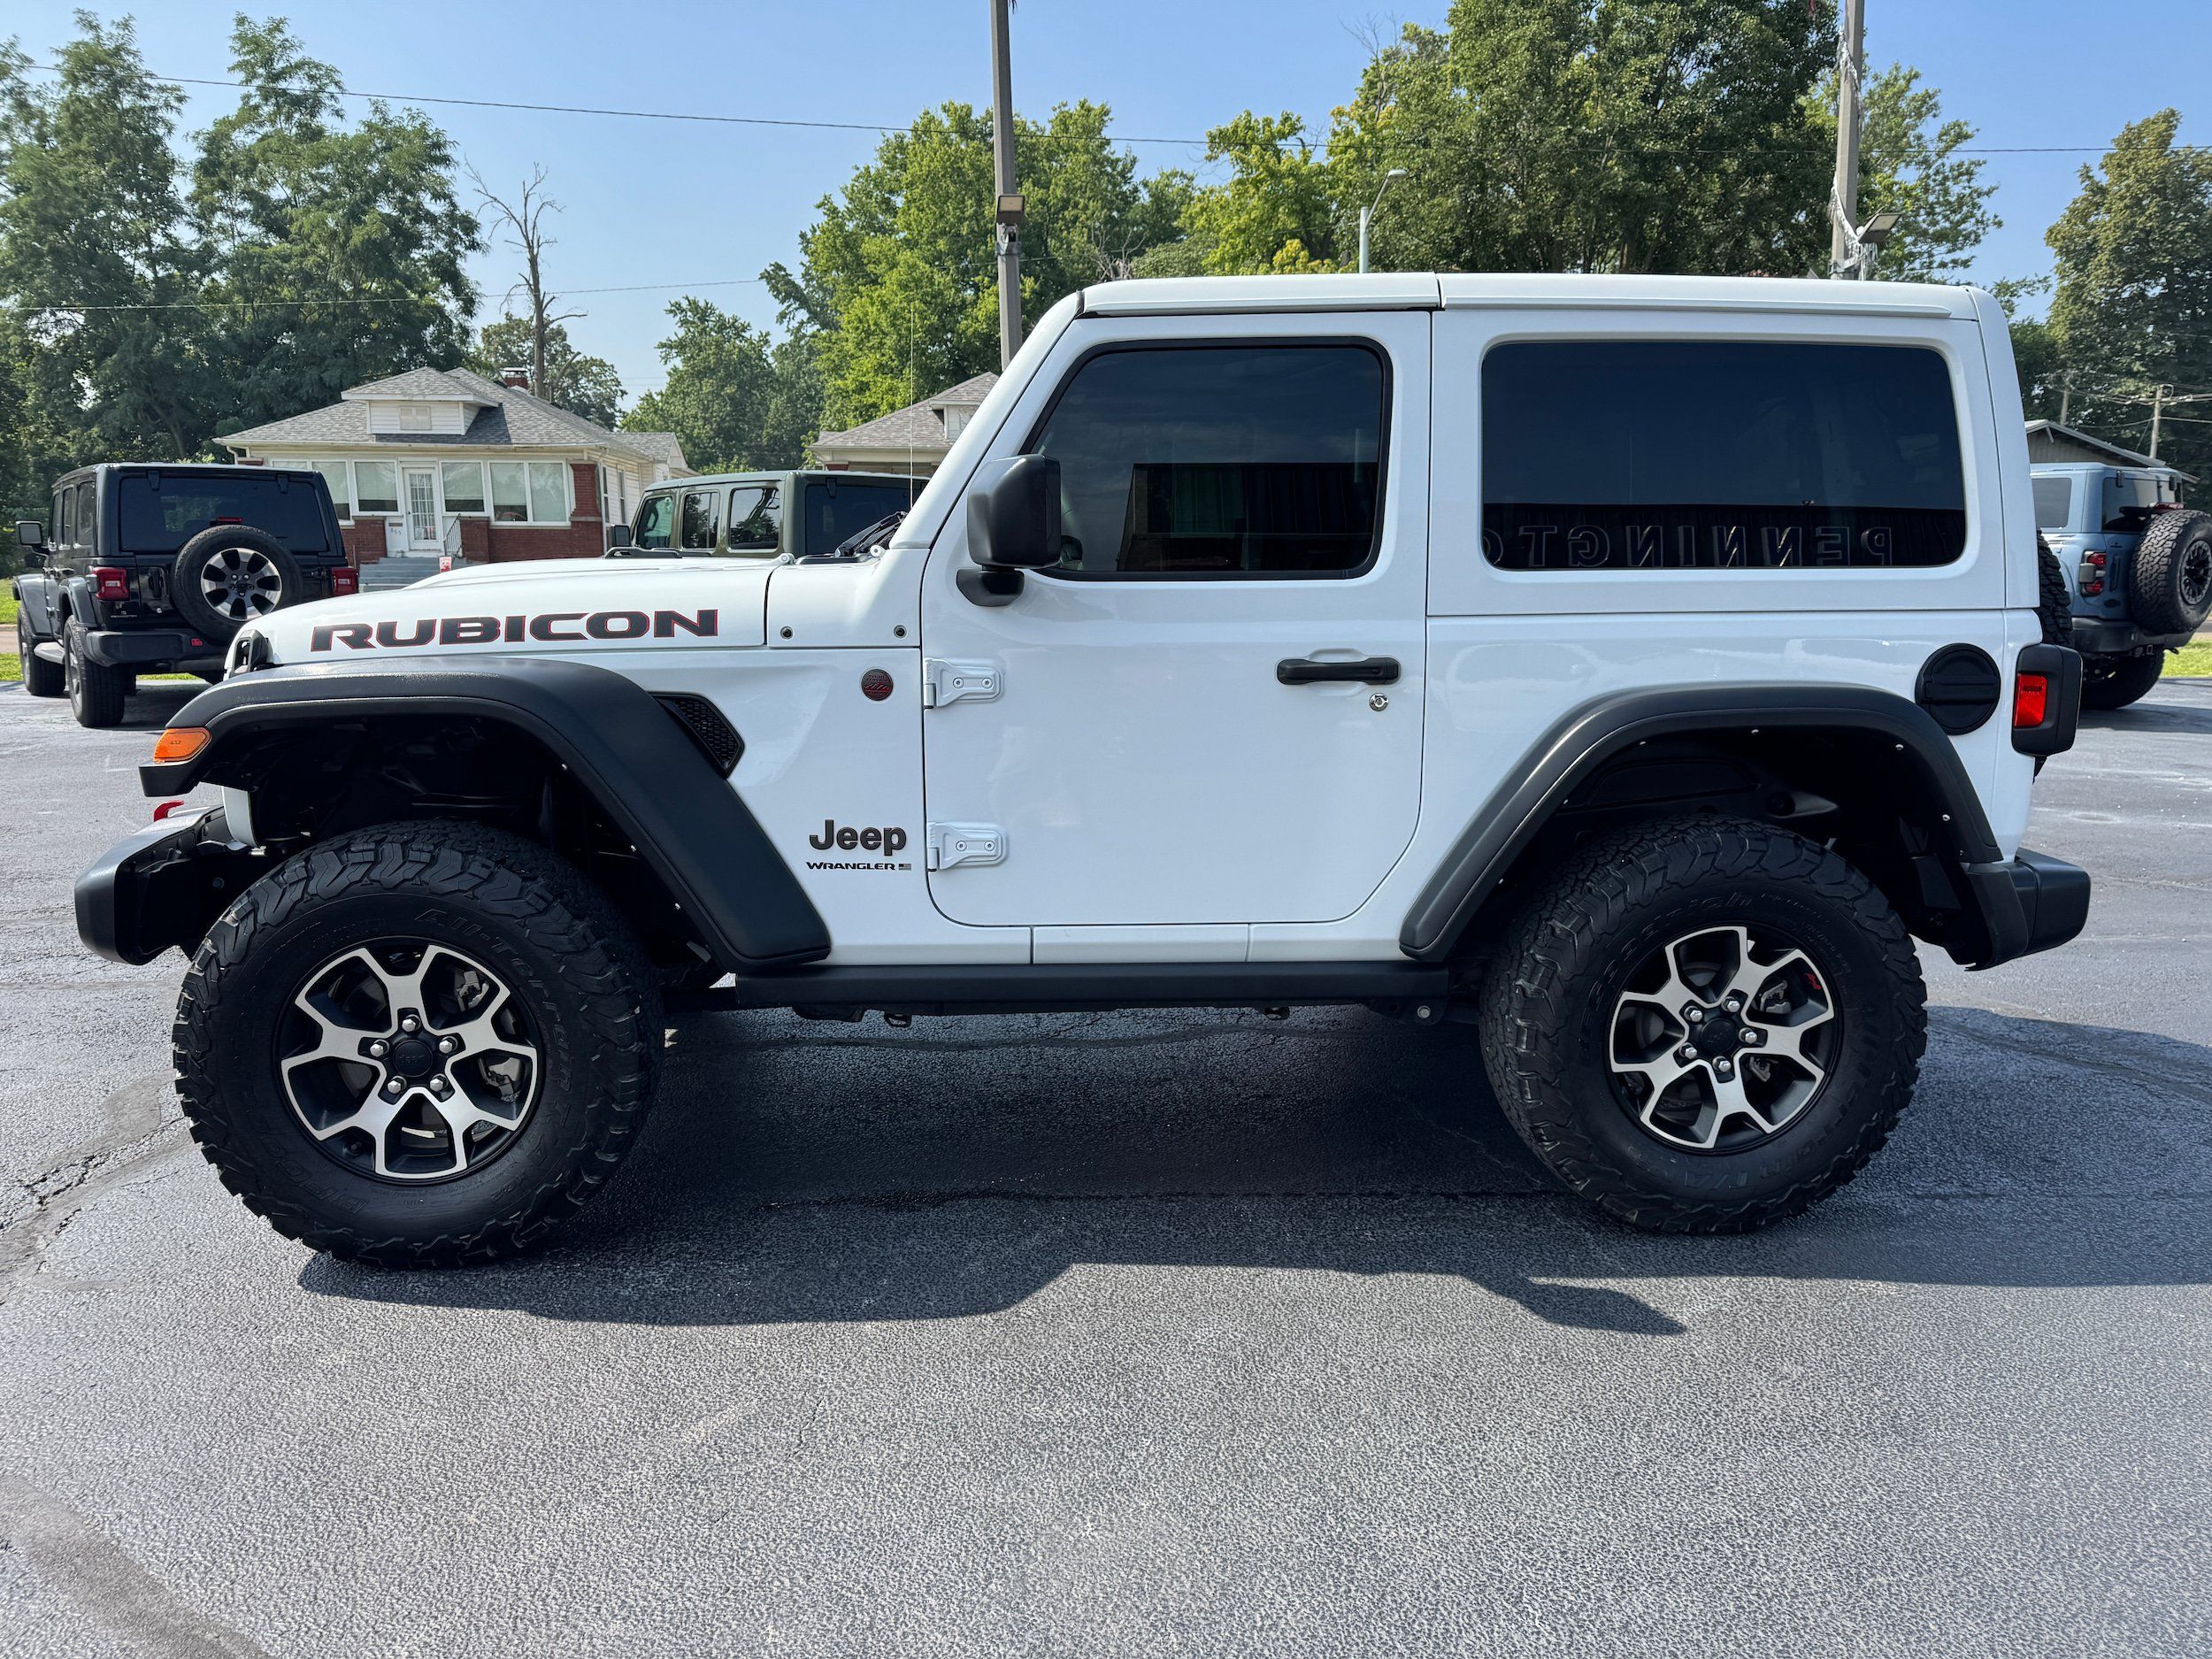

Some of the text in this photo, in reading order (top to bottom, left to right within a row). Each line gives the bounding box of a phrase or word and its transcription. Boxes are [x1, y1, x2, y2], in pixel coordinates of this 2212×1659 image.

[310, 608, 718, 653] RUBICON
[809, 818, 907, 856] Jeep
[805, 861, 895, 871] WRANGLER
